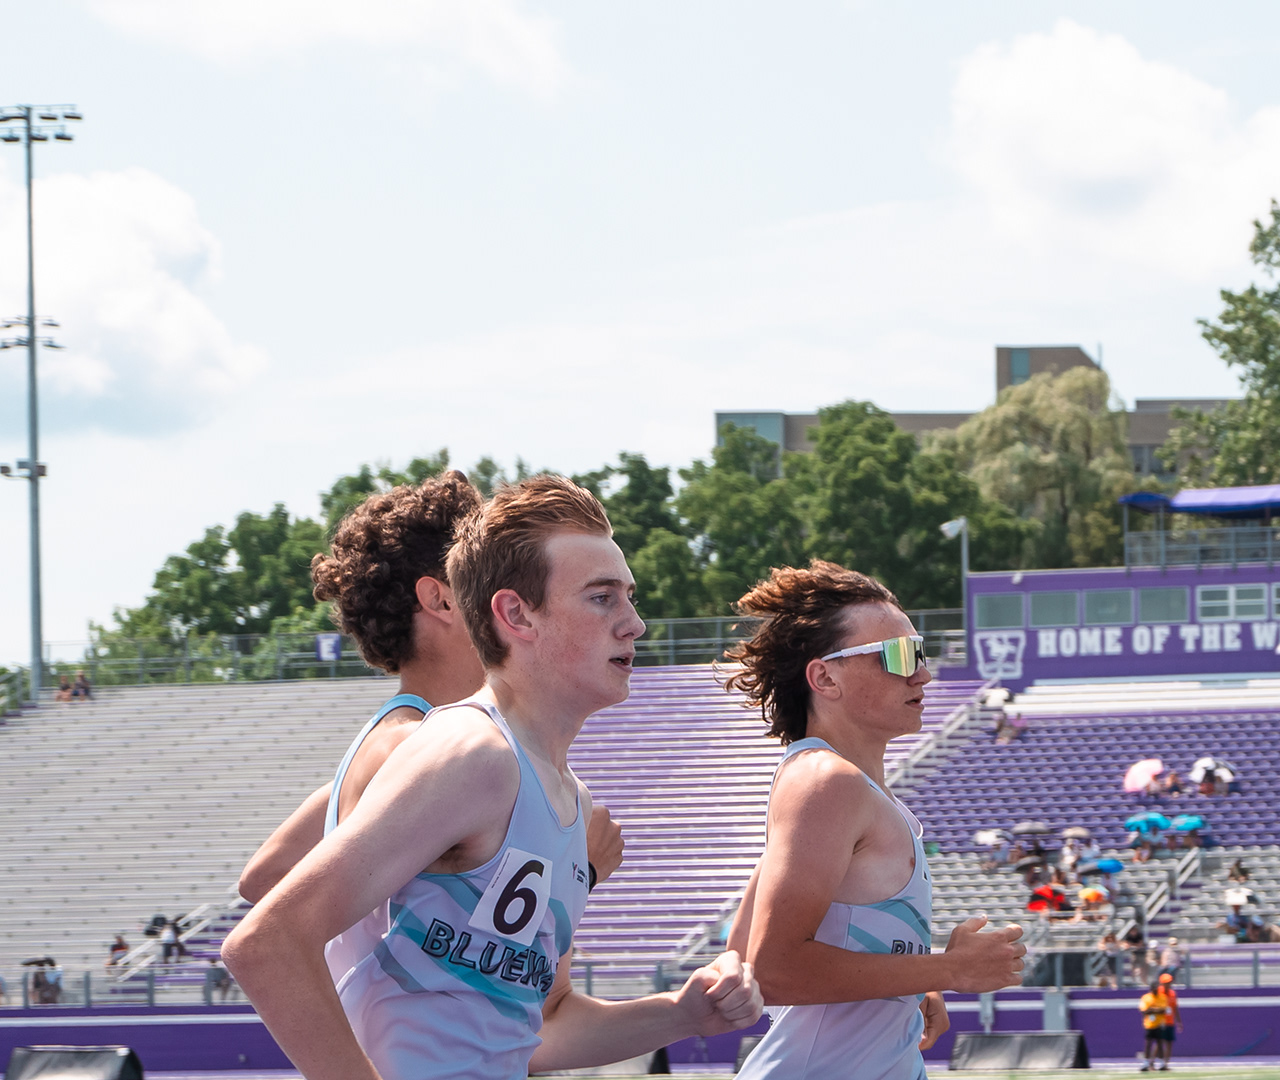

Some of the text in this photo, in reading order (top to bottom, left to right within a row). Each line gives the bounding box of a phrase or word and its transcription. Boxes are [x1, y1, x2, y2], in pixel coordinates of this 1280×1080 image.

[1037, 626, 1123, 658] HOME
[1131, 625, 1171, 655] OF
[1180, 623, 1242, 652] THE
[492, 859, 545, 936] 6
